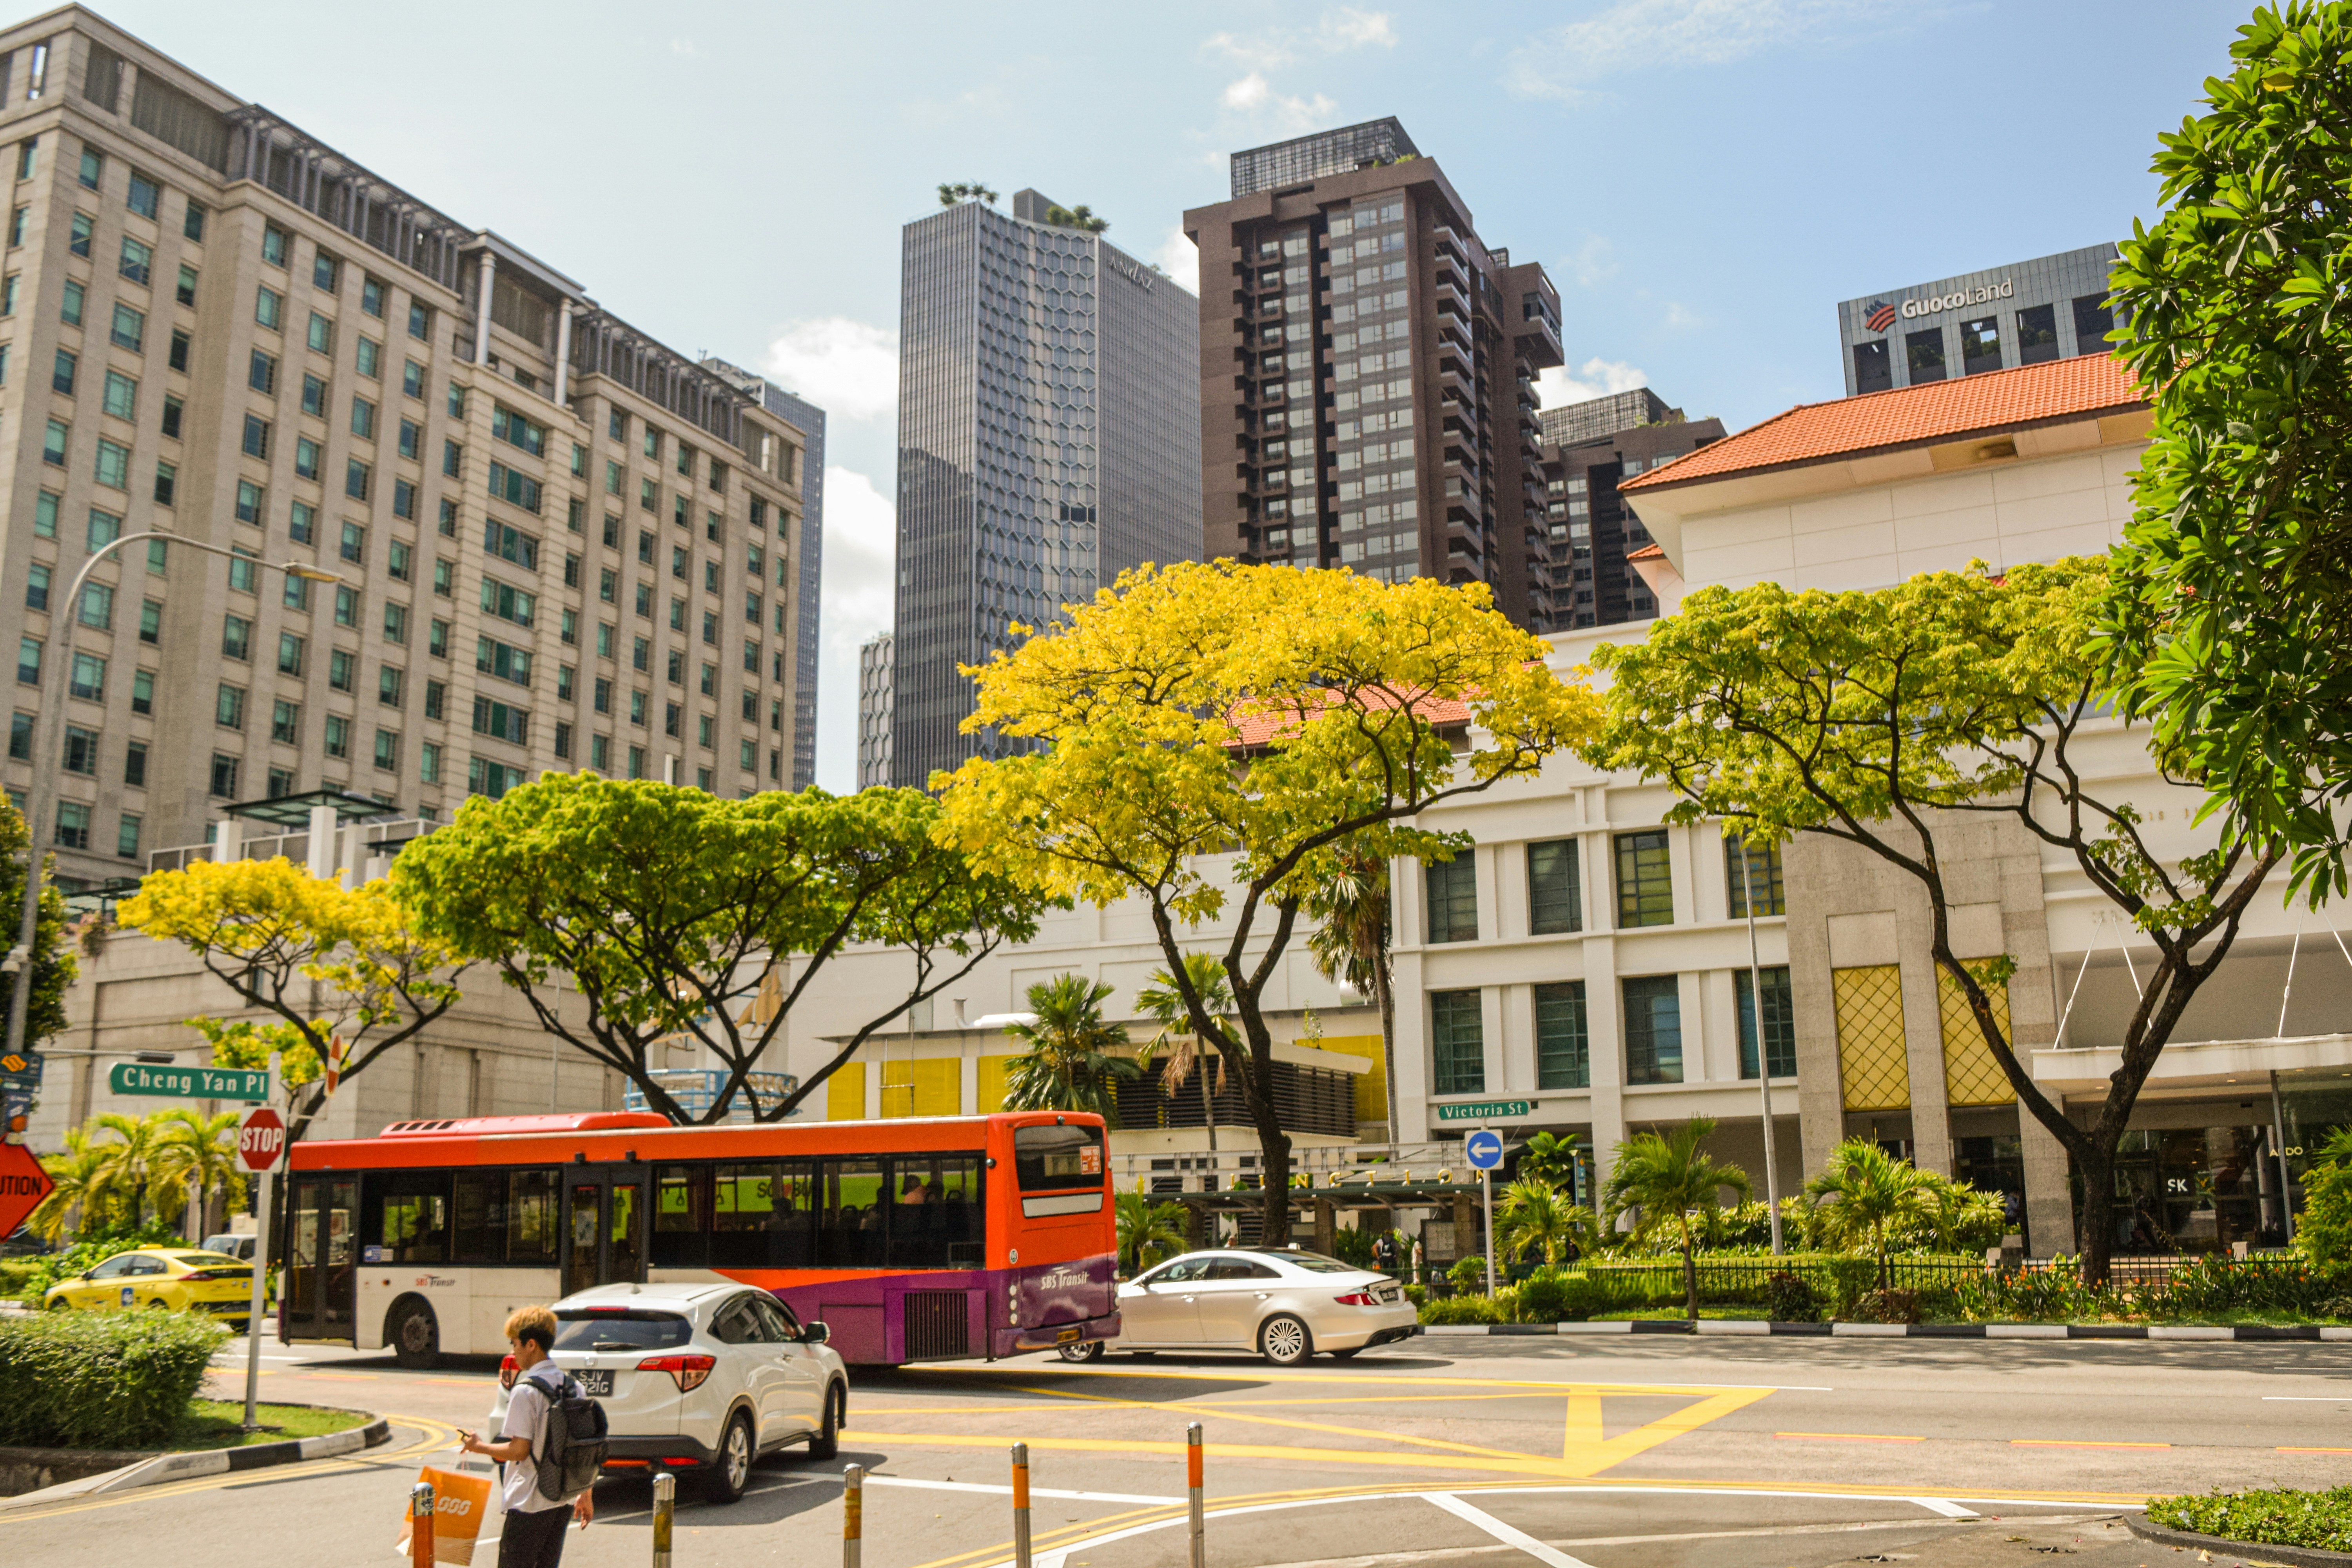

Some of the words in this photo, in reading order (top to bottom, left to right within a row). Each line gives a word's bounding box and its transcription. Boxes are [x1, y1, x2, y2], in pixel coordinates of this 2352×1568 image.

[1901, 278, 2013, 318] GuocoLand
[123, 1067, 192, 1094] Cheng
[202, 1072, 237, 1092] Yan
[1445, 1104, 1503, 1118] Victoria
[1509, 1103, 1522, 1114] St
[241, 1127, 283, 1152] STOP
[2269, 1146, 2303, 1157] ADO
[415, 1278, 428, 1286] SBS
[1041, 1275, 1057, 1290] SBS
[1055, 1269, 1090, 1289] Transit
[579, 1371, 604, 1381] SJV
